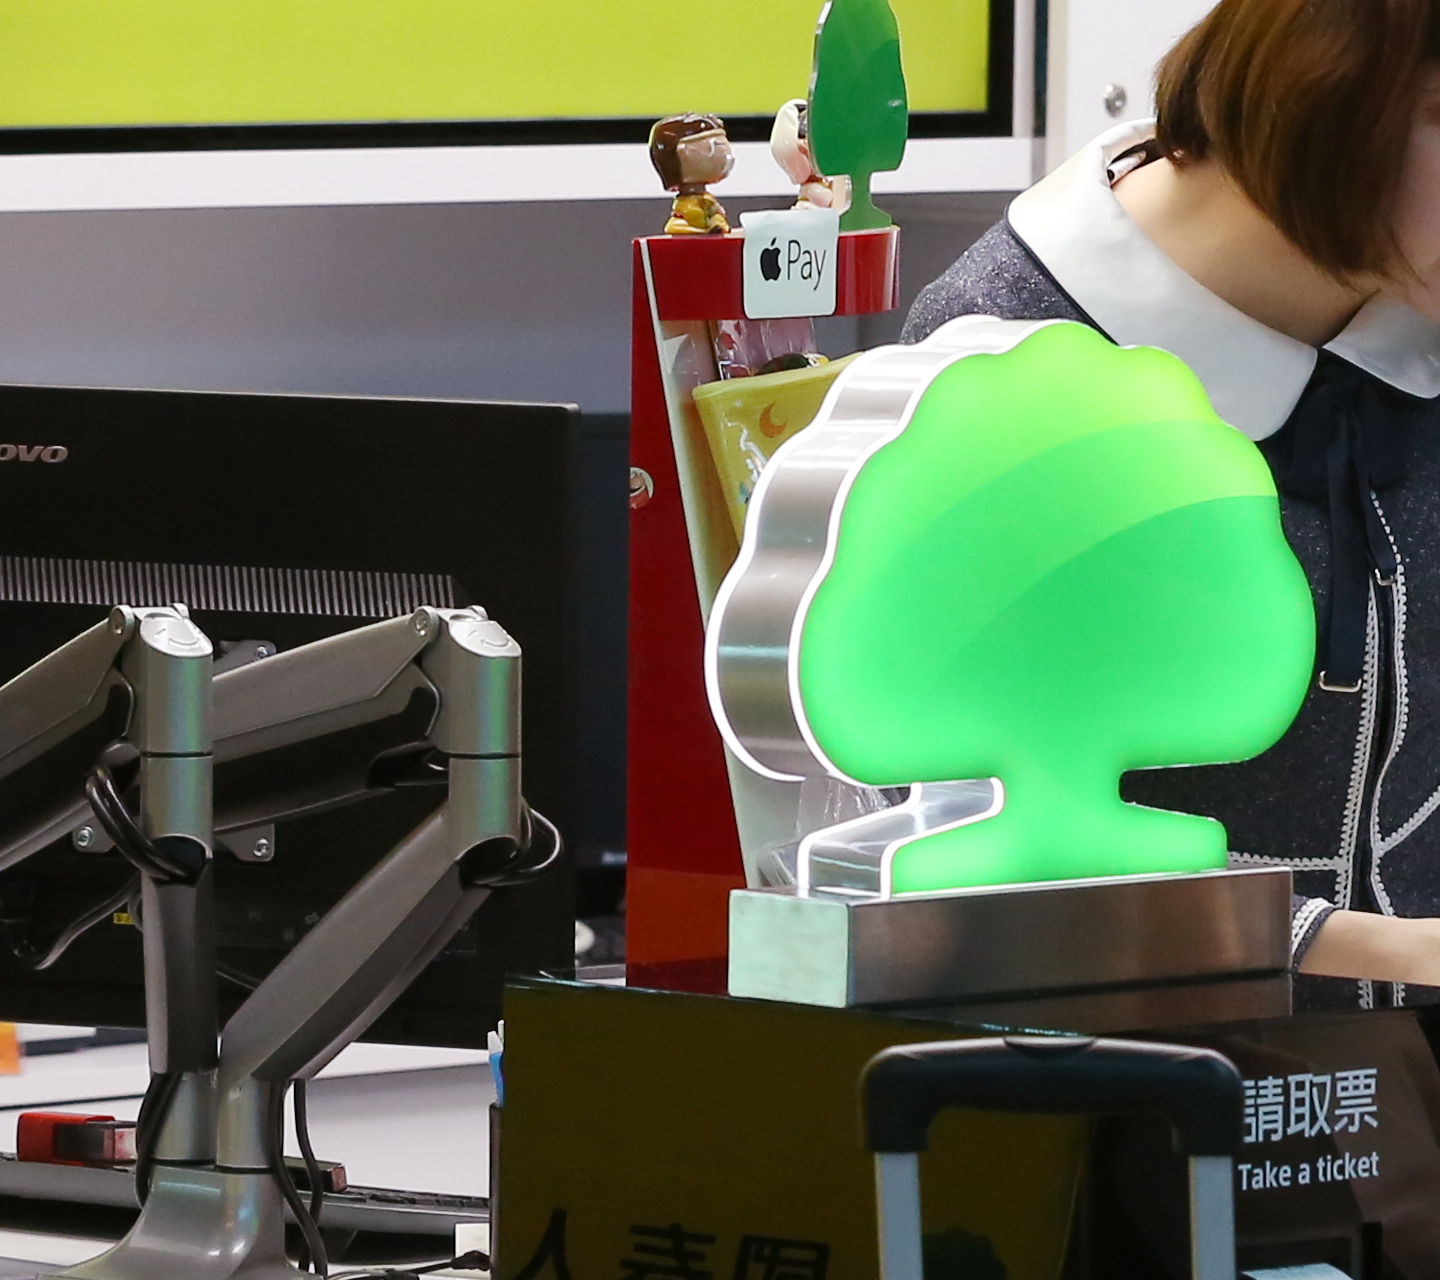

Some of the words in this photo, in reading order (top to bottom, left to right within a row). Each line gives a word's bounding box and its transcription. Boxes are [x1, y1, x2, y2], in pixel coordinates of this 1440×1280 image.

[787, 239, 827, 291] Pay
[1242, 1068, 1379, 1143] 請取票
[1238, 1160, 1291, 1191] Take
[1298, 1163, 1311, 1186] a
[1317, 1151, 1380, 1183] ticket
